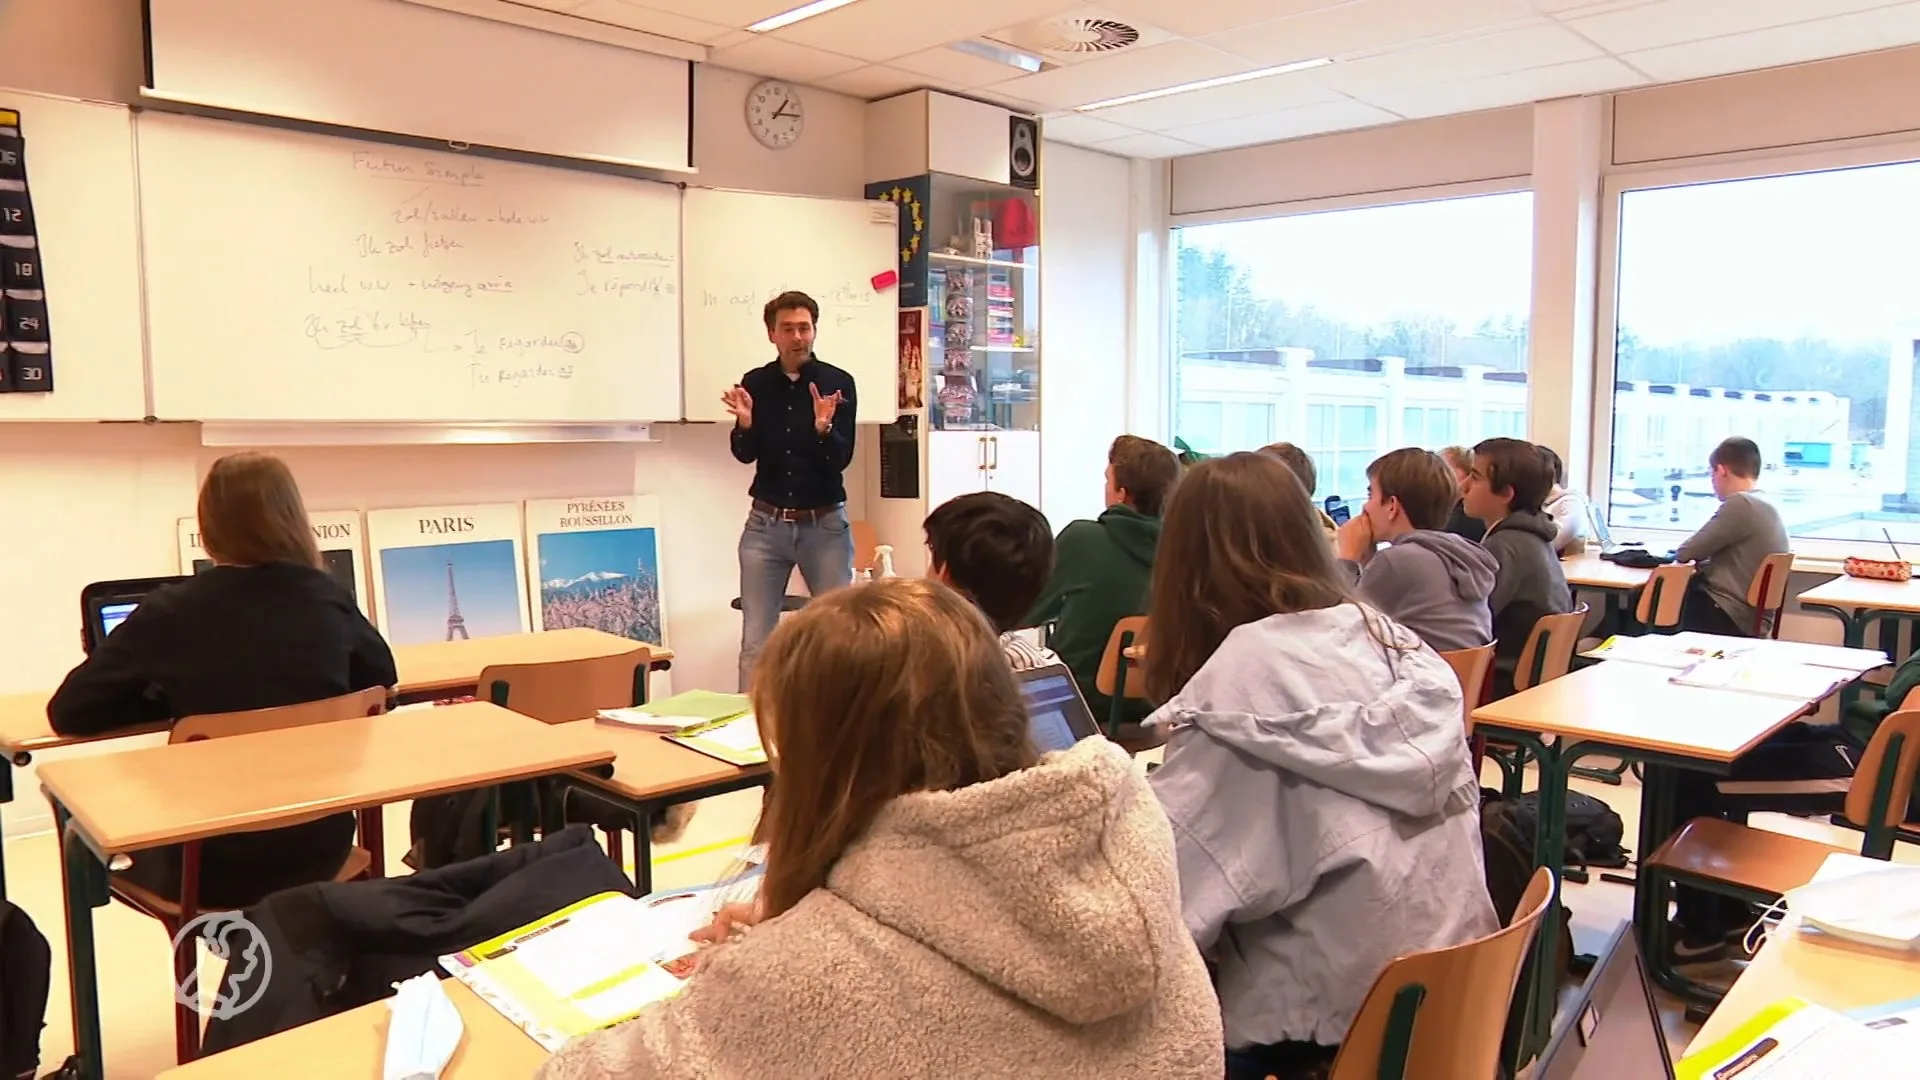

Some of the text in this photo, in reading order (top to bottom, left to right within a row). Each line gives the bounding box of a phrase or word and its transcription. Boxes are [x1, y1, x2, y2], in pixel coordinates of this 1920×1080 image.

[4, 207, 23, 222] 12
[18, 317, 40, 331] 24
[21, 367, 43, 381] 30
[567, 499, 626, 514] PYRÉNÉES
[419, 516, 476, 534] PARIS
[559, 513, 633, 528] ROUSSILLON
